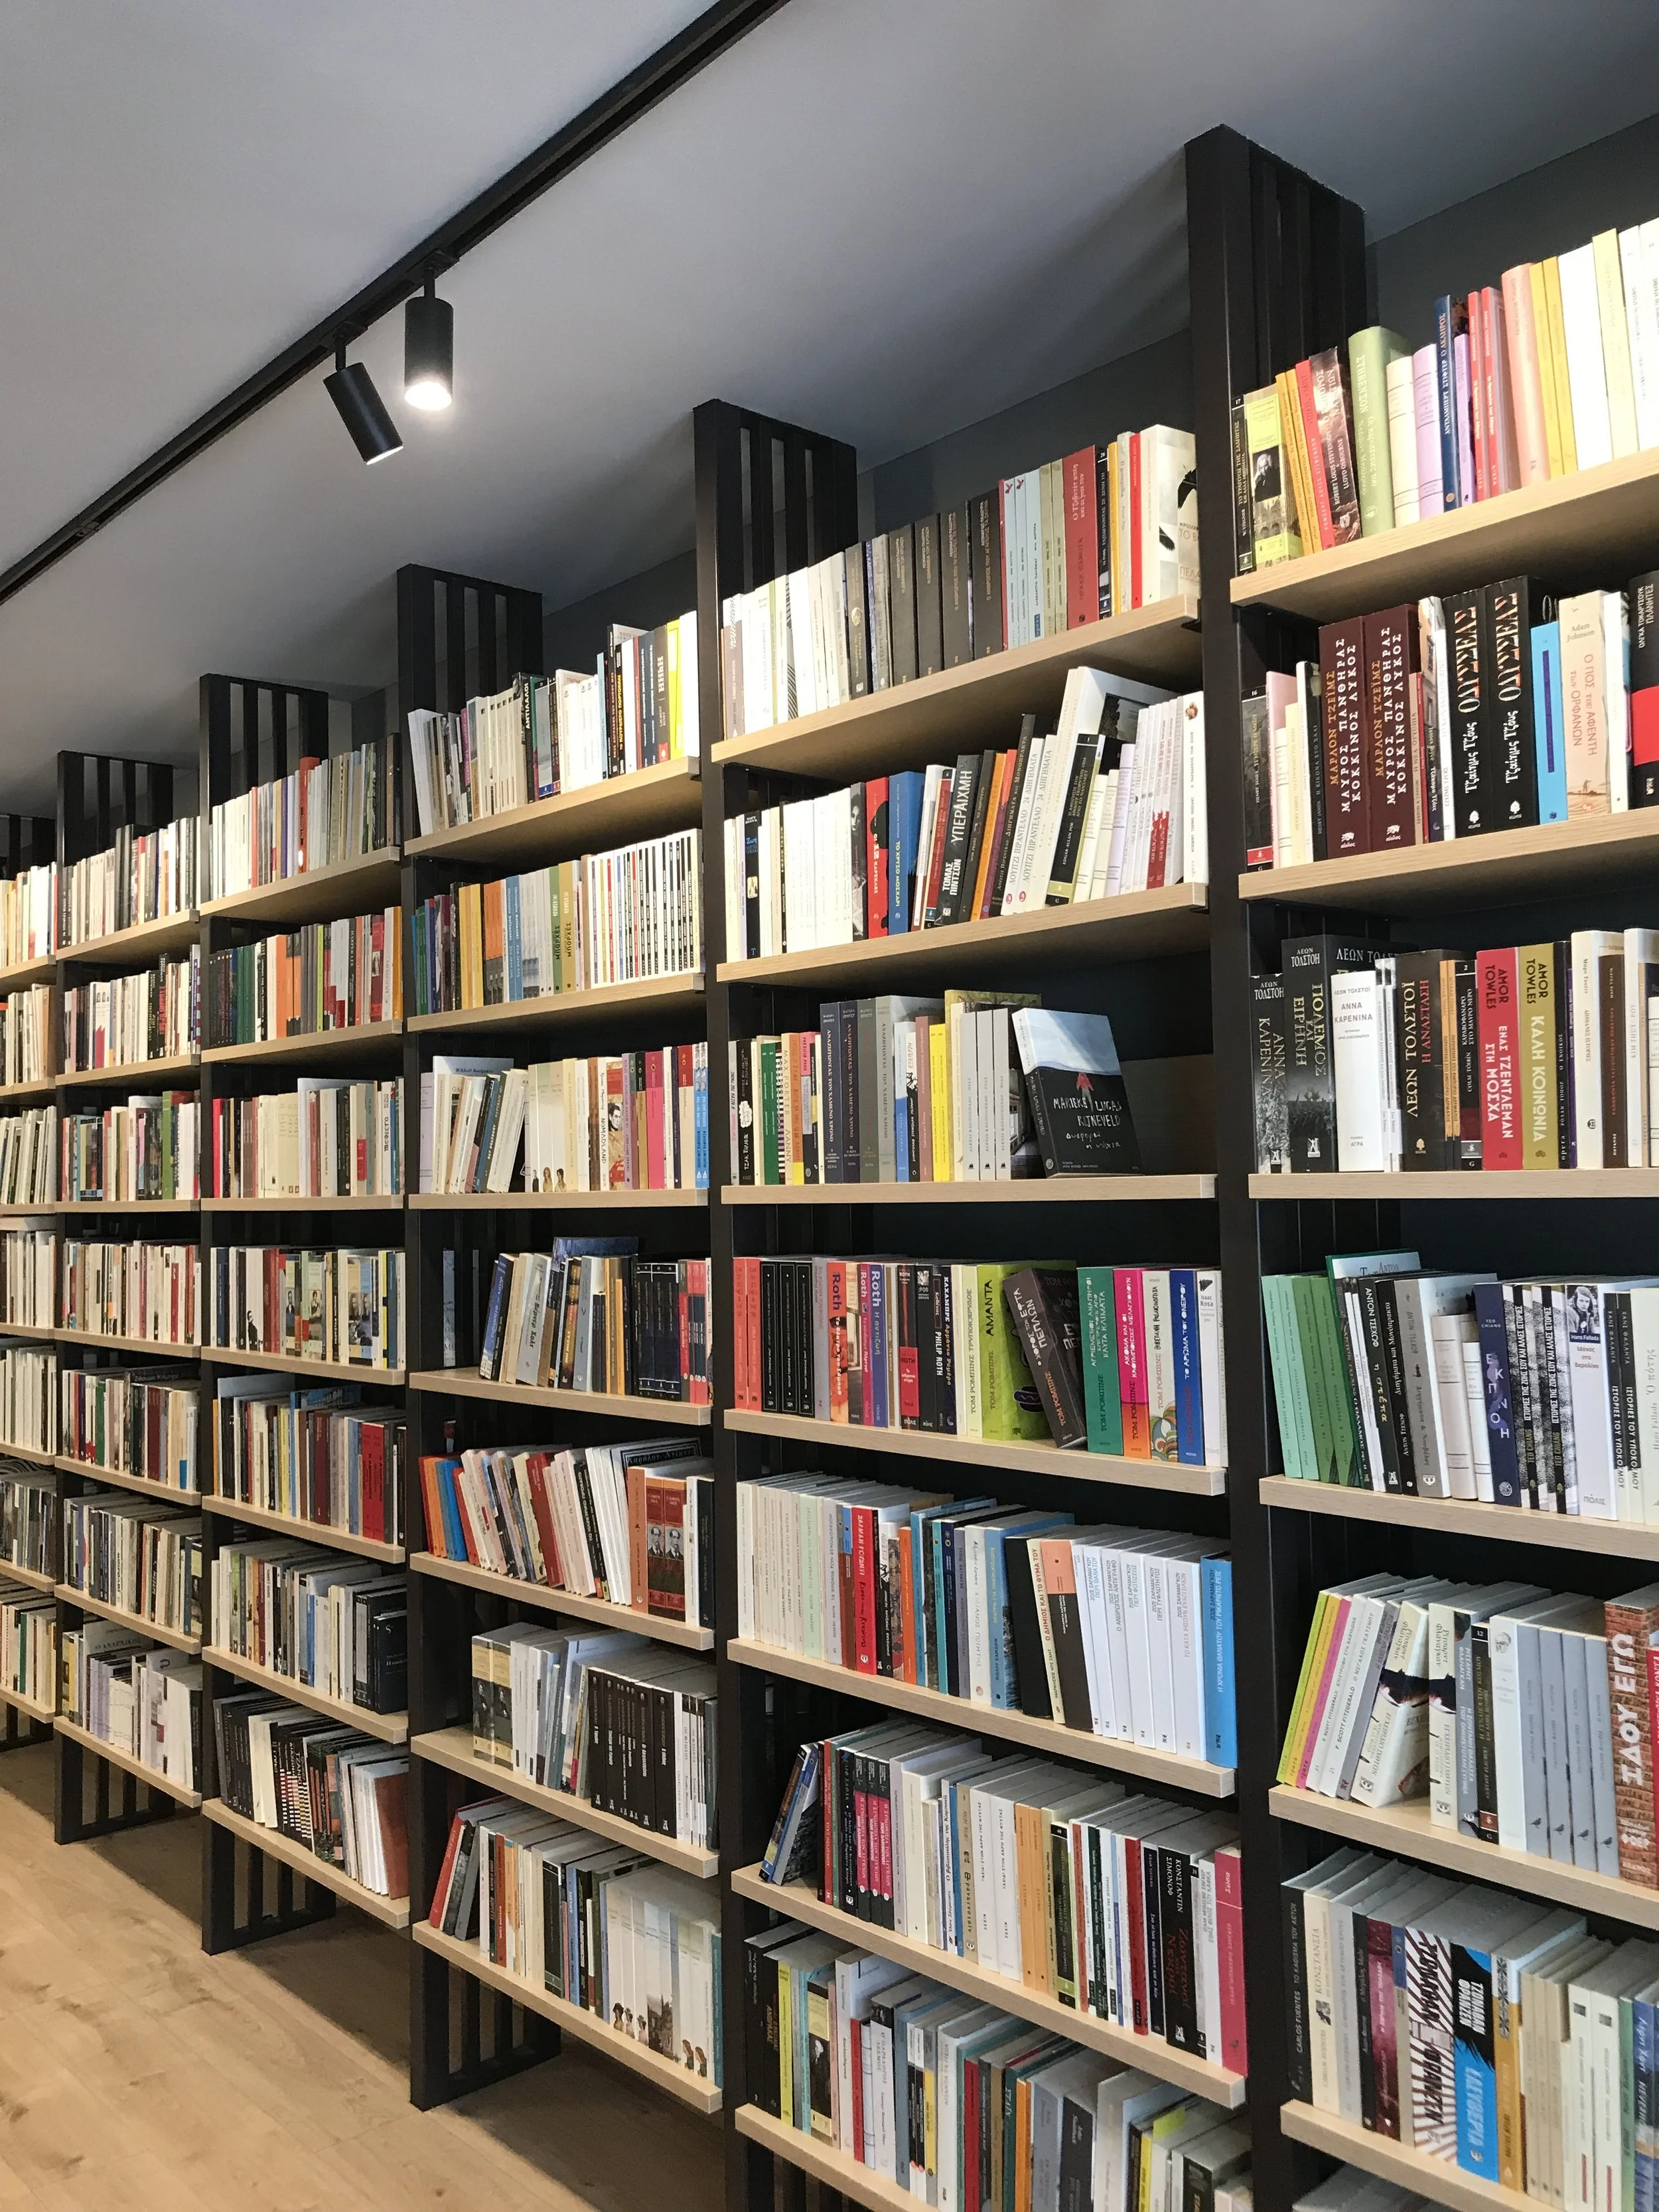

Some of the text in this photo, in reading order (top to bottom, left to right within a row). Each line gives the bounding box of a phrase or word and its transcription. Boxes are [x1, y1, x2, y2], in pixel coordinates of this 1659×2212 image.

[1356, 355, 1368, 413] ΣΤΗΒΕΝΣΟΝ
[1645, 583, 1654, 624] ΠΛΑΝΗΤΕΣ
[1566, 629, 1595, 642] Johnson
[1571, 623, 1590, 632] Adam
[1336, 638, 1350, 812] ΜΑΥΡΟΣ ΠΑΝΘΗΡΑΣ
[1347, 645, 1360, 801] ΚΟΚΚΙΝΟΣ ΛΥΚΟΣ
[1571, 690, 1583, 747] ΟΡΦΑΝΩΝ
[1327, 728, 1338, 785] ΜΑΡΛΟΝ
[1463, 745, 1480, 794] Τζαίημς
[951, 770, 973, 844] ΥΠΕΡΑΙΧΜΗ
[873, 834, 878, 842] ΟΙ
[873, 843, 879, 859] 12
[896, 840, 901, 850] ΤΟ
[1009, 854, 1020, 885] ΛΟΥΙΤΖΙ
[1015, 809, 1027, 853] ΠΙΡΑΝΤΕΛΛΟ
[1023, 793, 1029, 804] 24
[942, 861, 953, 891] ΤΟΜΑΣ
[950, 859, 962, 896] ΠΙΝΤΣΟΝ
[1254, 987, 1284, 1001] ΤΟΛΣΤΟΗ
[1484, 965, 1496, 1009] TOWLES
[1498, 968, 1508, 1003] AMOR
[1293, 996, 1307, 1067] ΕΙΡΗΝΗ
[1312, 983, 1327, 1076] ΠΟΛΕΜΟΣ
[1420, 980, 1430, 1054] ΑΝΑΣΤΑΣΗ
[1258, 1017, 1273, 1096] ΚΑΡΕΝΙΝΑ
[1273, 1033, 1285, 1079] ΑΝΝΑ
[1402, 980, 1418, 1118] ΛΕΩΝ ΤΟΛΣΤΟΪ
[1486, 1068, 1500, 1122] ΜΟΣΧΑ
[1498, 1025, 1514, 1138] ΕΝΑΣ ΤΖΕΝΤΛΕΜΑΝ
[1532, 1016, 1546, 1142] ΚΑΛΗ ΚΟΙΝΩΝΙΑ
[1053, 1098, 1122, 1111] MARIEKE LUCAS
[1078, 1115, 1121, 1127] RIJNEVELD
[832, 1274, 842, 1310] Roth
[984, 1280, 993, 1337] ΑΜΑΝΤΑ
[1025, 1299, 1047, 1349] ΠΕΠΛΩΝ
[1364, 1288, 1378, 1347] ΑΝΤΟΝ ΤΣΕΧΩΦ
[1516, 1330, 1525, 1347] ΑΛΛΕΣ
[1184, 1368, 1189, 1380] ΤΟ
[1520, 1370, 1529, 1384] ΖΩΗΣ
[1523, 1397, 1532, 1421] ΙΣΤΟΡΙΕΣ
[1038, 1582, 1043, 1592] ΤΟ
[1042, 1607, 1050, 1635] ΔΗΜΙΟΣ
[1342, 1686, 1355, 1722] FITZGERALD
[1354, 1647, 1366, 1674] ΜΕΓΑΛΟΣ
[1611, 1633, 1642, 1787] ΙΔΟΥ ΕΓΩ
